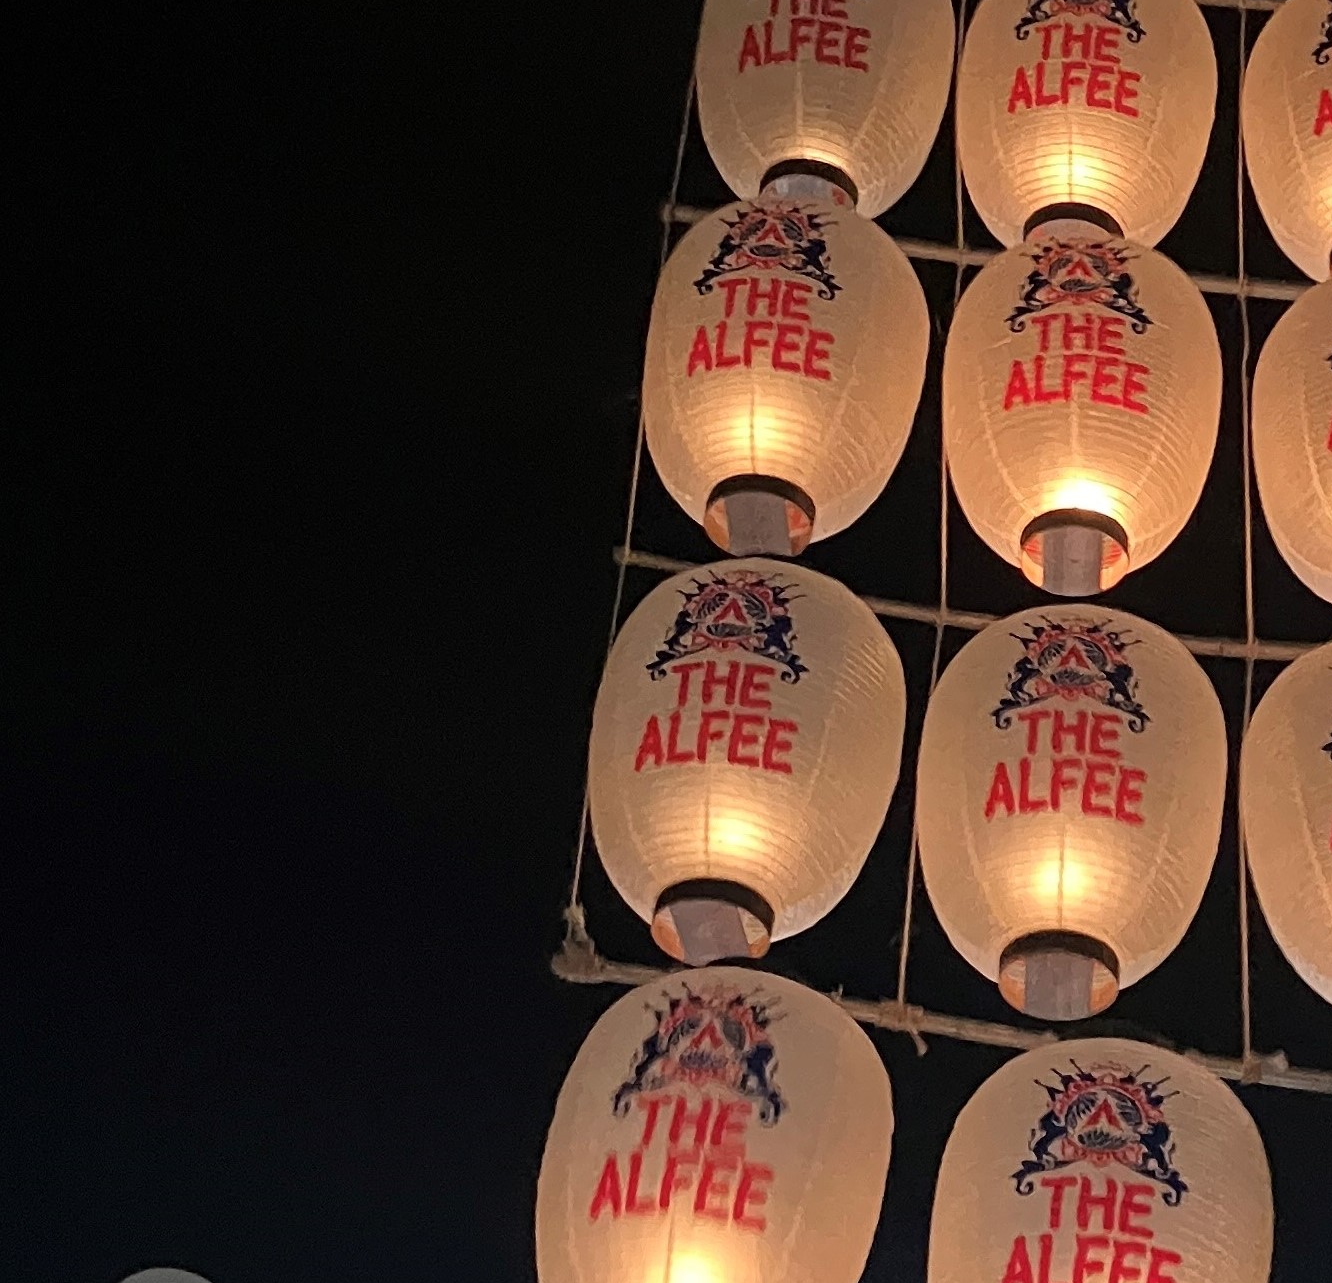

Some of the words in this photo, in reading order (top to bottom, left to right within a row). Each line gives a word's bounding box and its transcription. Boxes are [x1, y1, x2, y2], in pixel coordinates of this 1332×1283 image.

[738, 20, 872, 74] ALFEE
[1036, 25, 1122, 65] THE
[1008, 61, 1141, 118] ALFEE
[718, 278, 812, 321] THE
[687, 321, 836, 381] ALFEE
[1031, 314, 1126, 356] THE
[1004, 355, 1151, 414] ALFEE
[671, 661, 776, 711] THE
[635, 711, 800, 775] ALFEE
[1018, 710, 1123, 760] THE
[985, 758, 1148, 826] ALFEE
[637, 1095, 753, 1159] THE
[589, 1150, 775, 1232] ALFEE
[1041, 1176, 1156, 1240] THE
